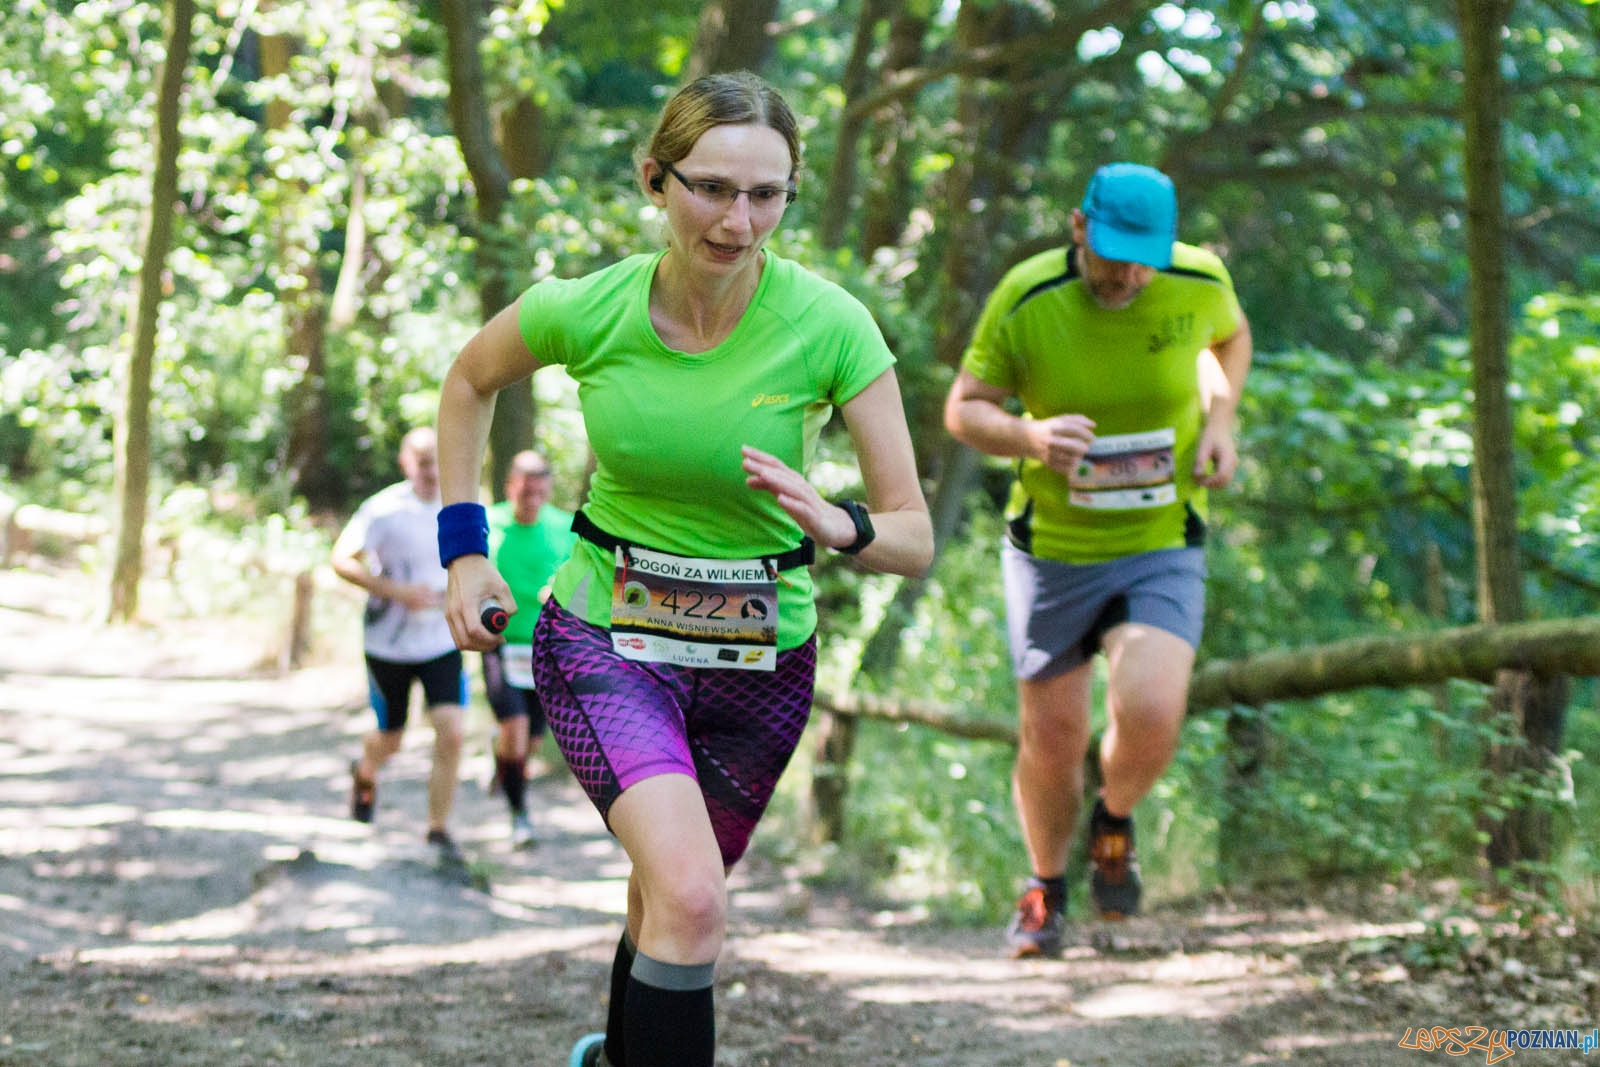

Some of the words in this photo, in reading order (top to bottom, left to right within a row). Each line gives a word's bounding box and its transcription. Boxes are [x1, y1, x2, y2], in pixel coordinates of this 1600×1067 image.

[684, 567, 703, 579] ZA
[707, 569, 765, 580] WILKIEM
[660, 589, 727, 620] 422
[647, 616, 674, 628] ANNA
[673, 654, 710, 664] LUVENA
